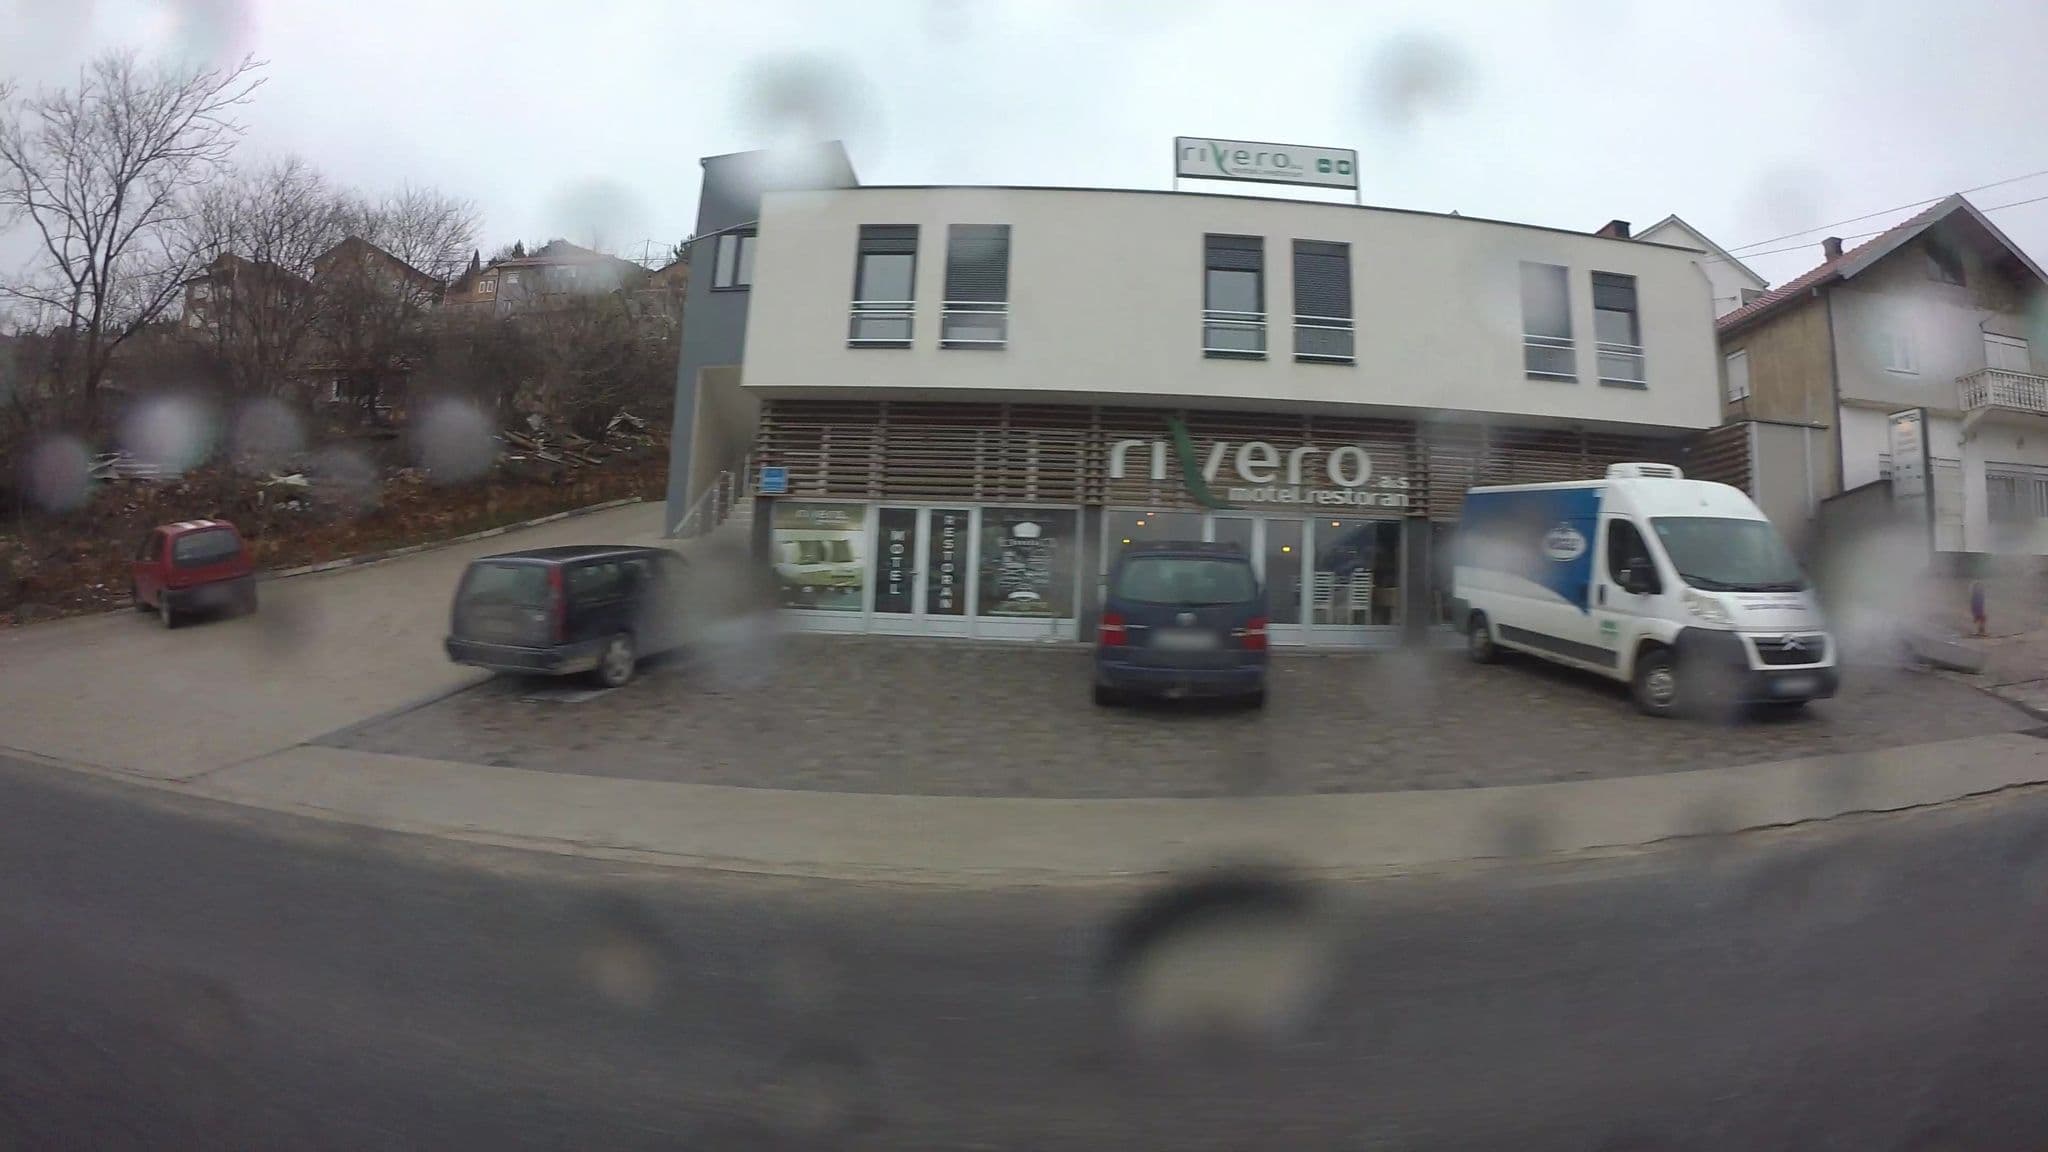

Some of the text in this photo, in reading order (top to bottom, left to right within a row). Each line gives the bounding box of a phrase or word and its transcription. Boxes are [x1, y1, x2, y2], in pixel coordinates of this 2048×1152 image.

[1182, 141, 1290, 174] rivero
[1109, 420, 1372, 503] rivero
[1306, 488, 1409, 507] restoran
[940, 515, 955, 609] RESTORAN
